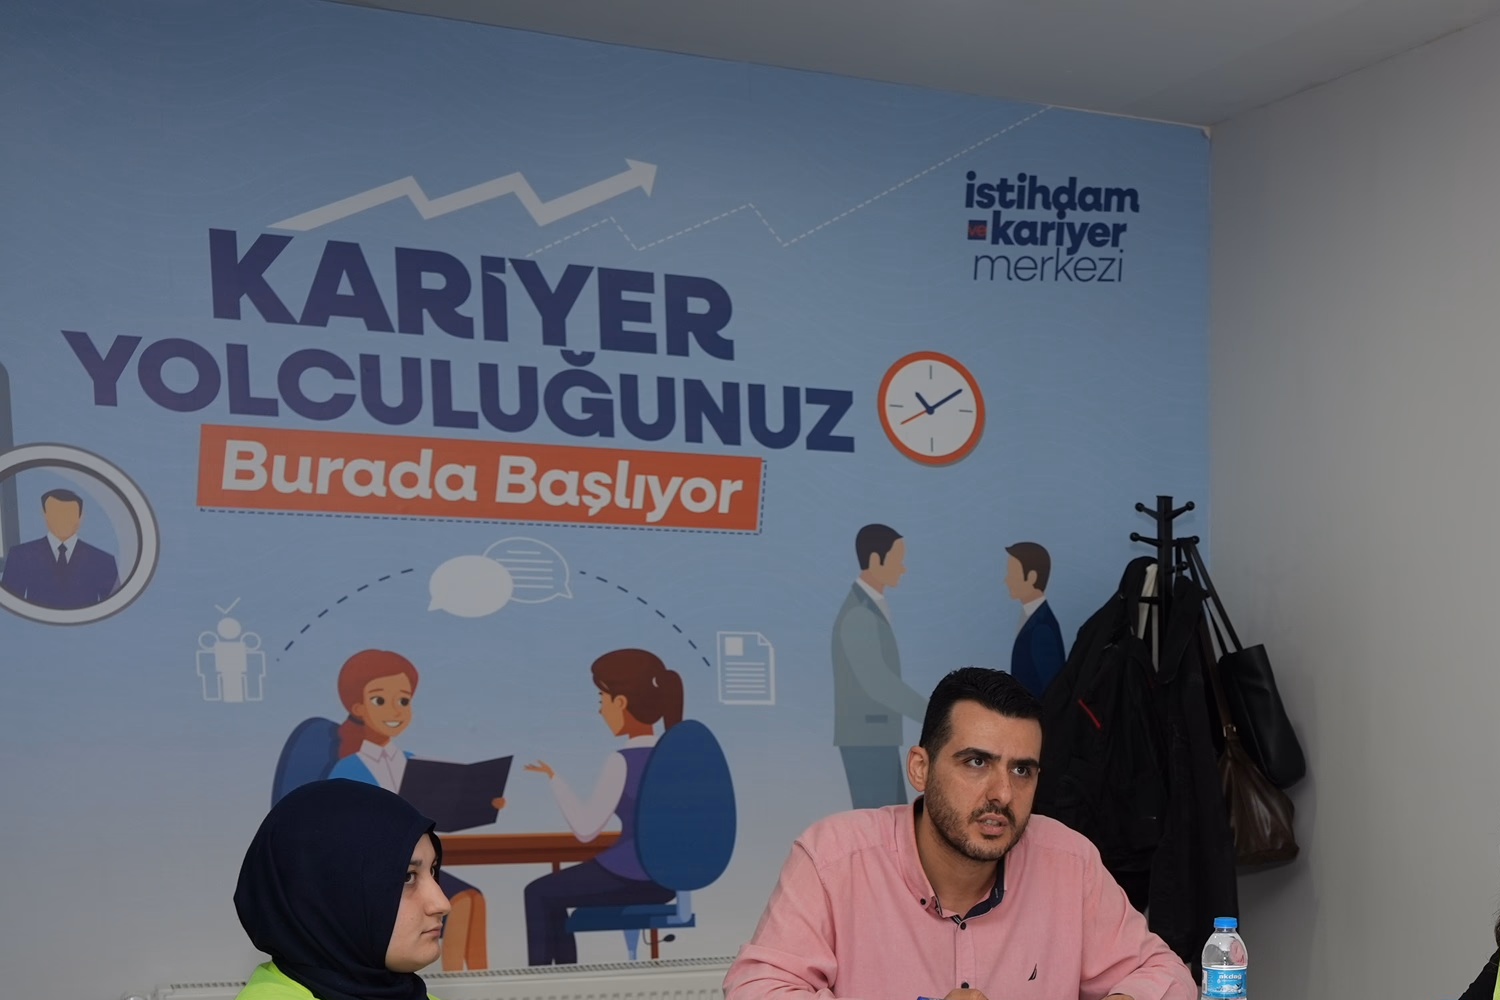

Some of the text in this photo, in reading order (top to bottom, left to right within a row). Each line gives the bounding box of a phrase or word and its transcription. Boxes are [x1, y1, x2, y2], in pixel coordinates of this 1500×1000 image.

[965, 170, 1140, 213] istihdam
[968, 208, 1128, 256] ve kariyer
[973, 247, 1124, 283] merkezi
[60, 328, 856, 454] YOLCULUĞUNUZ
[221, 438, 744, 523] Burada Başlıyor
